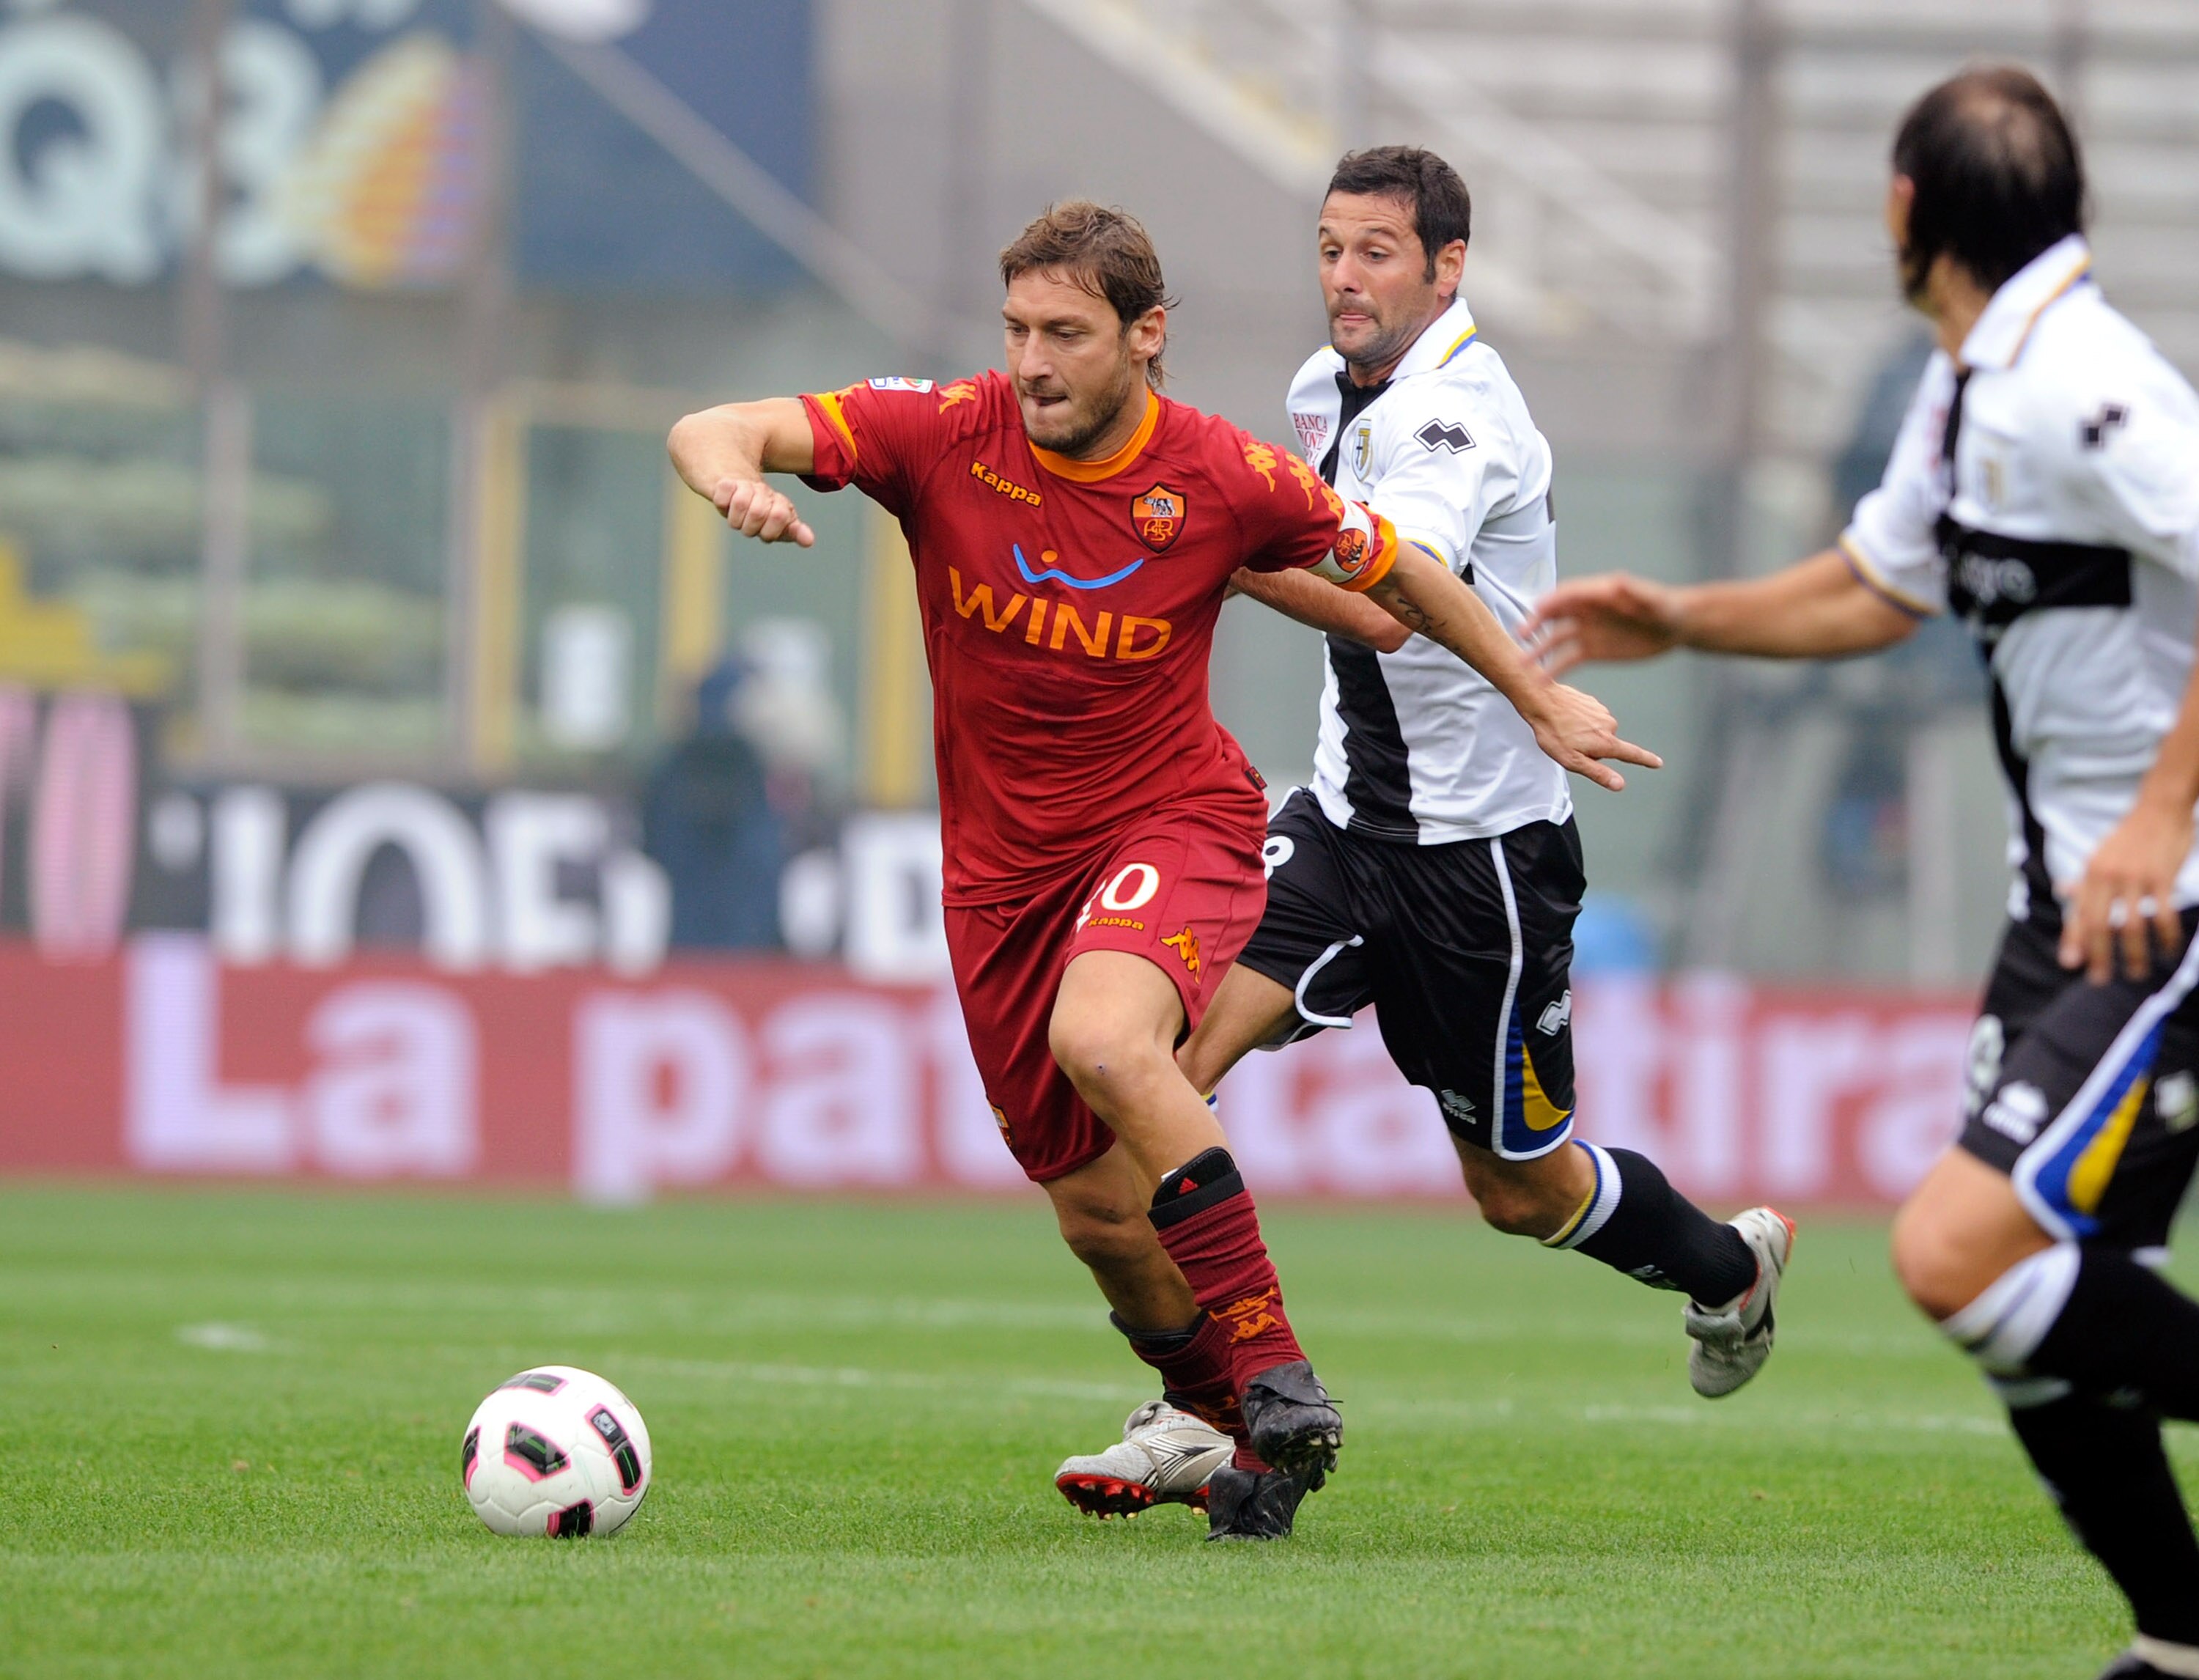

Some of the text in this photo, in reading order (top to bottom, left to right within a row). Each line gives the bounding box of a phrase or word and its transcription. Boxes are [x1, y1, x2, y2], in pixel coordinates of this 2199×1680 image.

[1292, 412, 1328, 433] BANCA
[969, 461, 1042, 507] Kappa
[949, 565, 1172, 660] WIND
[121, 931, 482, 1174] La
